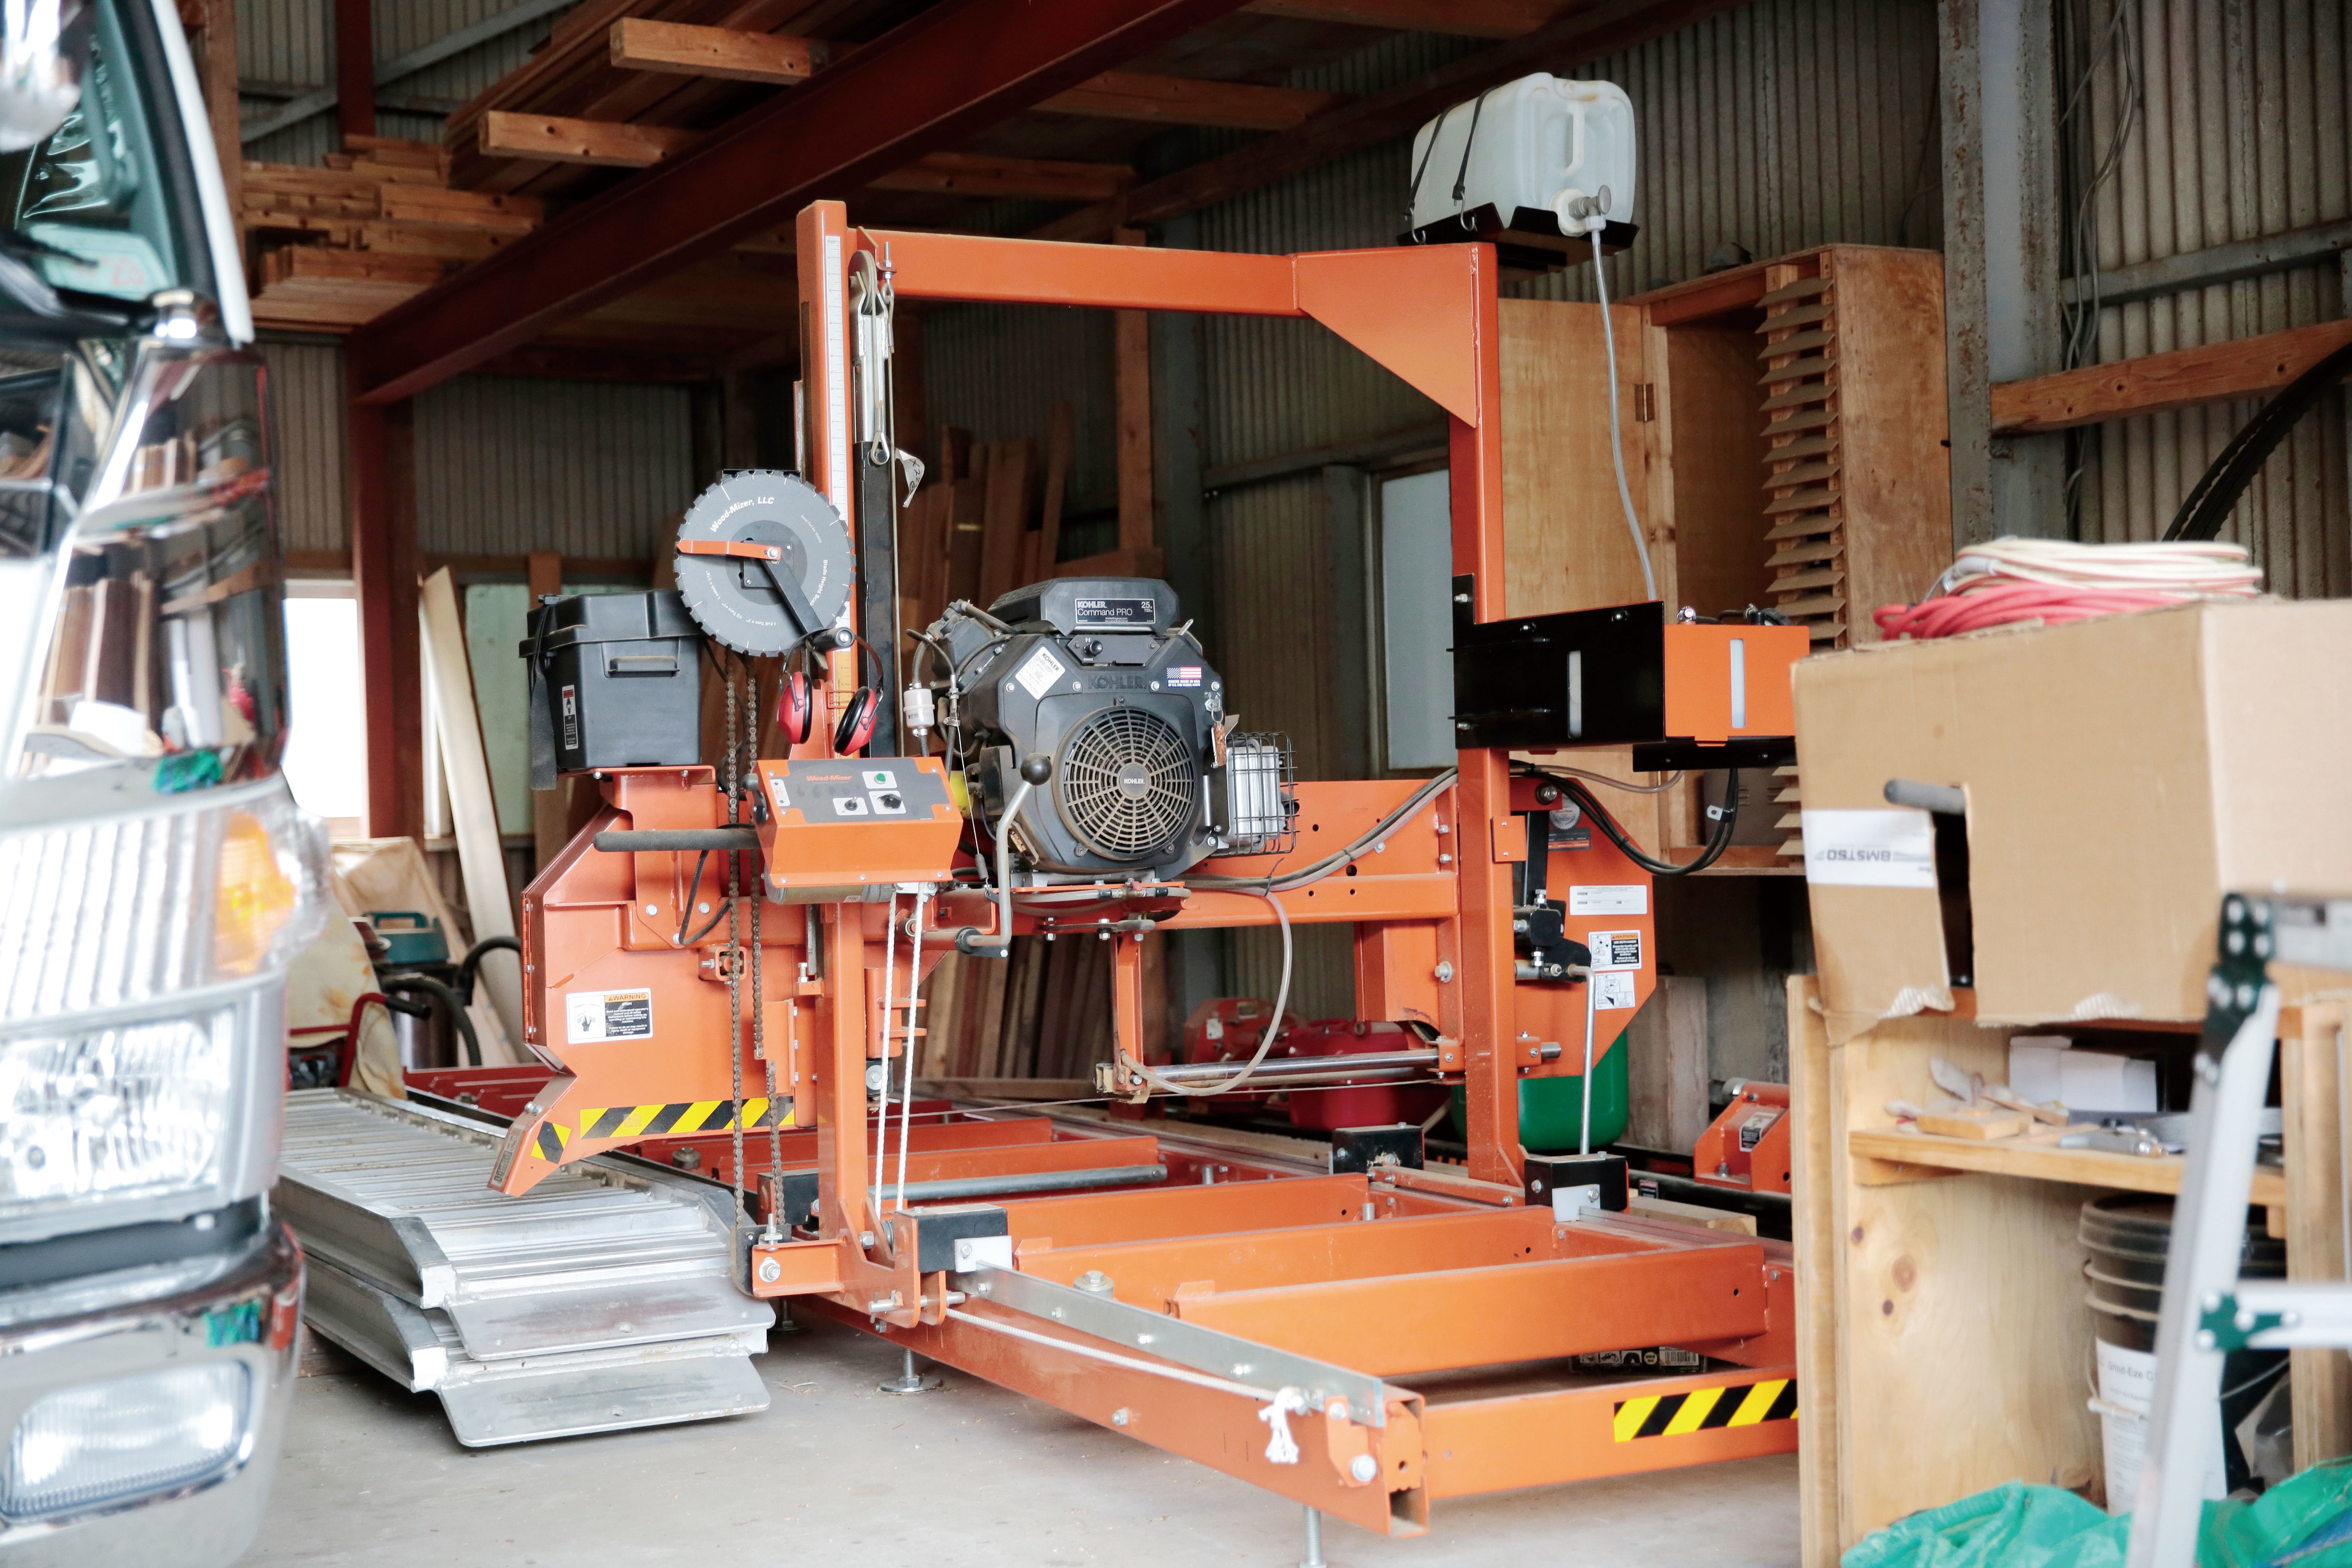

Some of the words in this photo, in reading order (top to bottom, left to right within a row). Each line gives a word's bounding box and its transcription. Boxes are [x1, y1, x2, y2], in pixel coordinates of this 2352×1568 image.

[710, 500, 755, 533] Wood-Mizer,
[757, 496, 775, 505] LLC
[817, 576, 827, 594] Height
[810, 594, 820, 606] Scal
[1042, 652, 1059, 672] KOHLER
